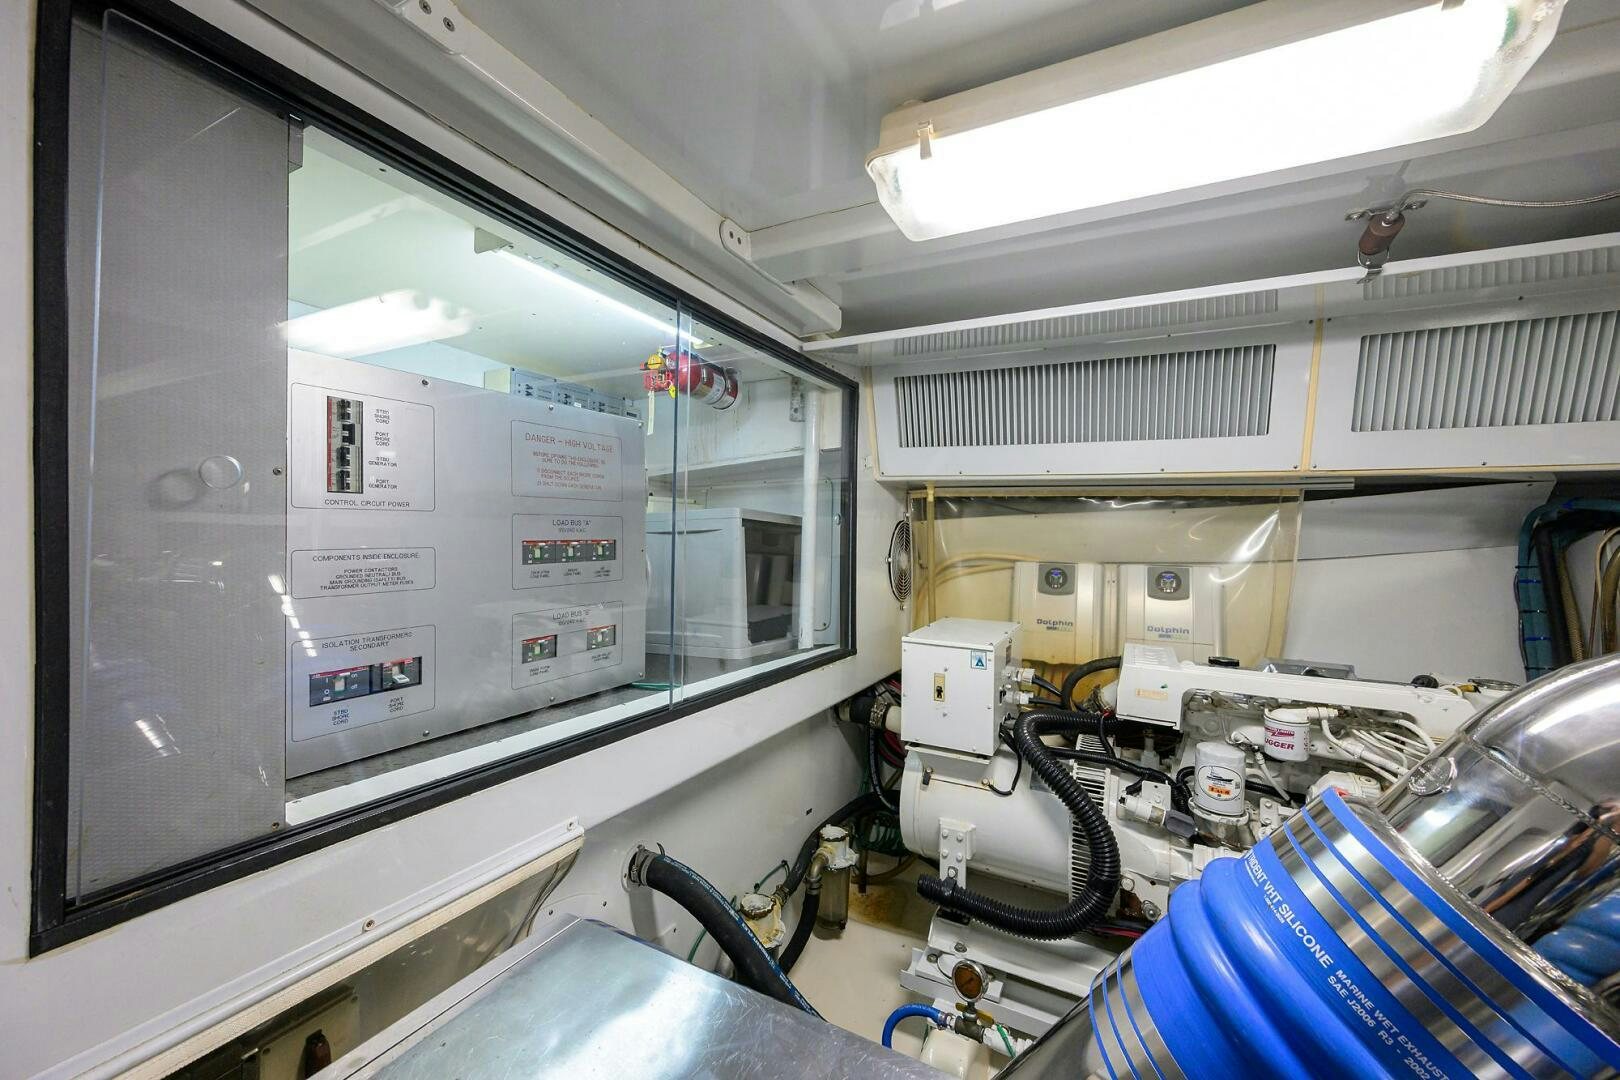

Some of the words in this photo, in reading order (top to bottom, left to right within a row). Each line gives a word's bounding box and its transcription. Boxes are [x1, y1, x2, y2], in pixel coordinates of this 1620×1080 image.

[525, 433, 556, 444] DANGER
[565, 439, 580, 448] HIGH
[582, 441, 614, 453] VOLTAGE
[313, 554, 361, 562] COMPONENTS
[384, 552, 420, 560] ENCLOSURE
[552, 611, 569, 620] LOAD
[1036, 618, 1073, 627] Dolphin
[1147, 625, 1190, 634] Dolphin
[322, 639, 360, 649] ISOLATION
[362, 631, 413, 644] TRANSFORMERS
[350, 641, 390, 651] SECONDARY
[1264, 737, 1295, 750] UGGER
[1244, 849, 1268, 883] TRIDENT
[1264, 881, 1283, 904] VHT
[1278, 903, 1333, 969] SILICONE
[1335, 969, 1375, 1010] MARINE
[1374, 1010, 1399, 1035] WET
[1327, 975, 1349, 998] SAE
[1347, 998, 1376, 1028] J2006
[1378, 1030, 1394, 1046] R3
[1404, 1057, 1430, 1080] 2002
